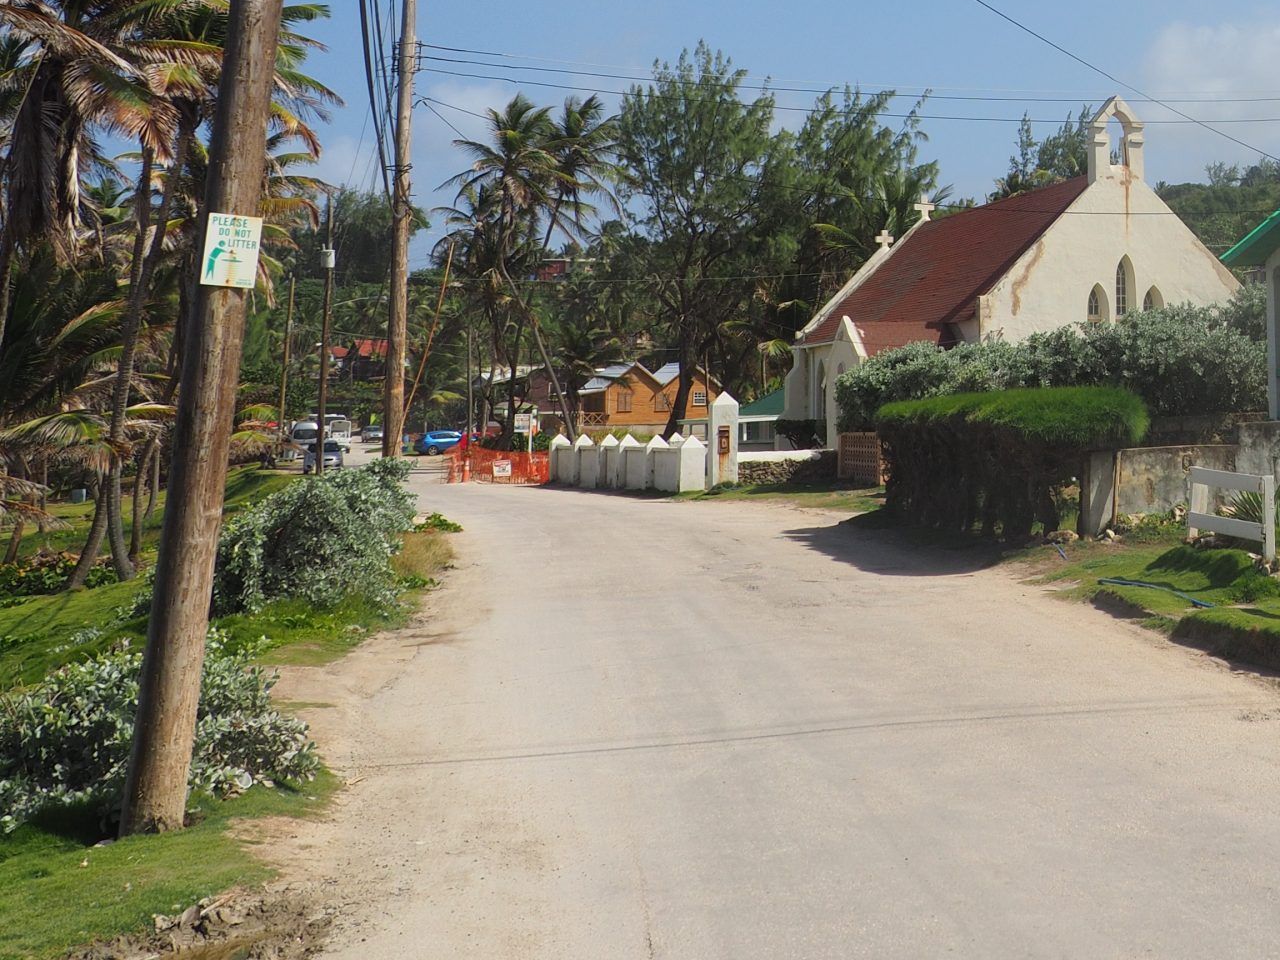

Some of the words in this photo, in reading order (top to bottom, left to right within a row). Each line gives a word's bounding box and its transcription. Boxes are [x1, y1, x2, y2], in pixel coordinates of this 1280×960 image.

[212, 216, 248, 228] PLEASE
[219, 228, 230, 236] DO
[235, 229, 252, 238] NOT
[228, 239, 257, 249] LITTER
